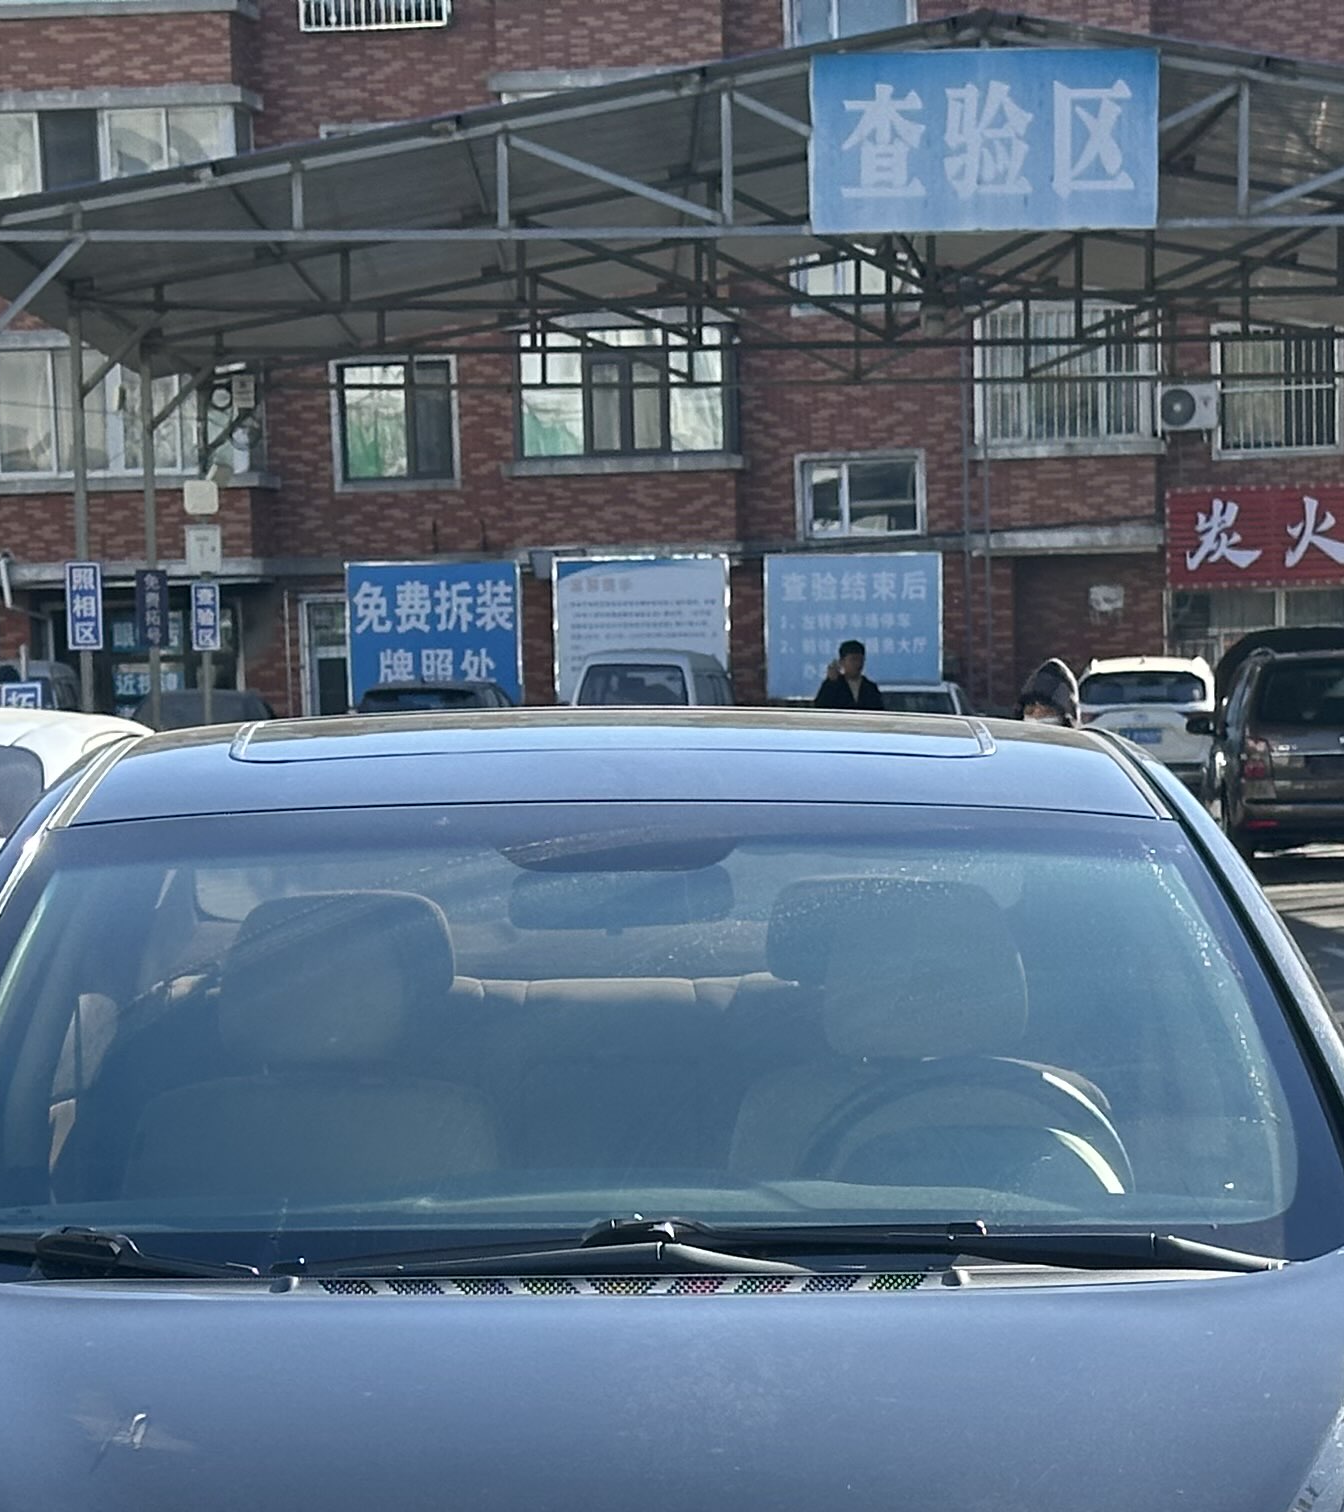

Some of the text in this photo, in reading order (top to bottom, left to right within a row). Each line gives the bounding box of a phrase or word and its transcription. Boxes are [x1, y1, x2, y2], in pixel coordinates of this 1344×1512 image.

[840, 79, 1136, 200] 查验区
[71, 567, 98, 645] 照相区
[352, 579, 516, 635] 免费拆装
[781, 569, 928, 602] 查验结束后
[195, 587, 216, 648] 查验区
[379, 647, 498, 684] 牌照处
